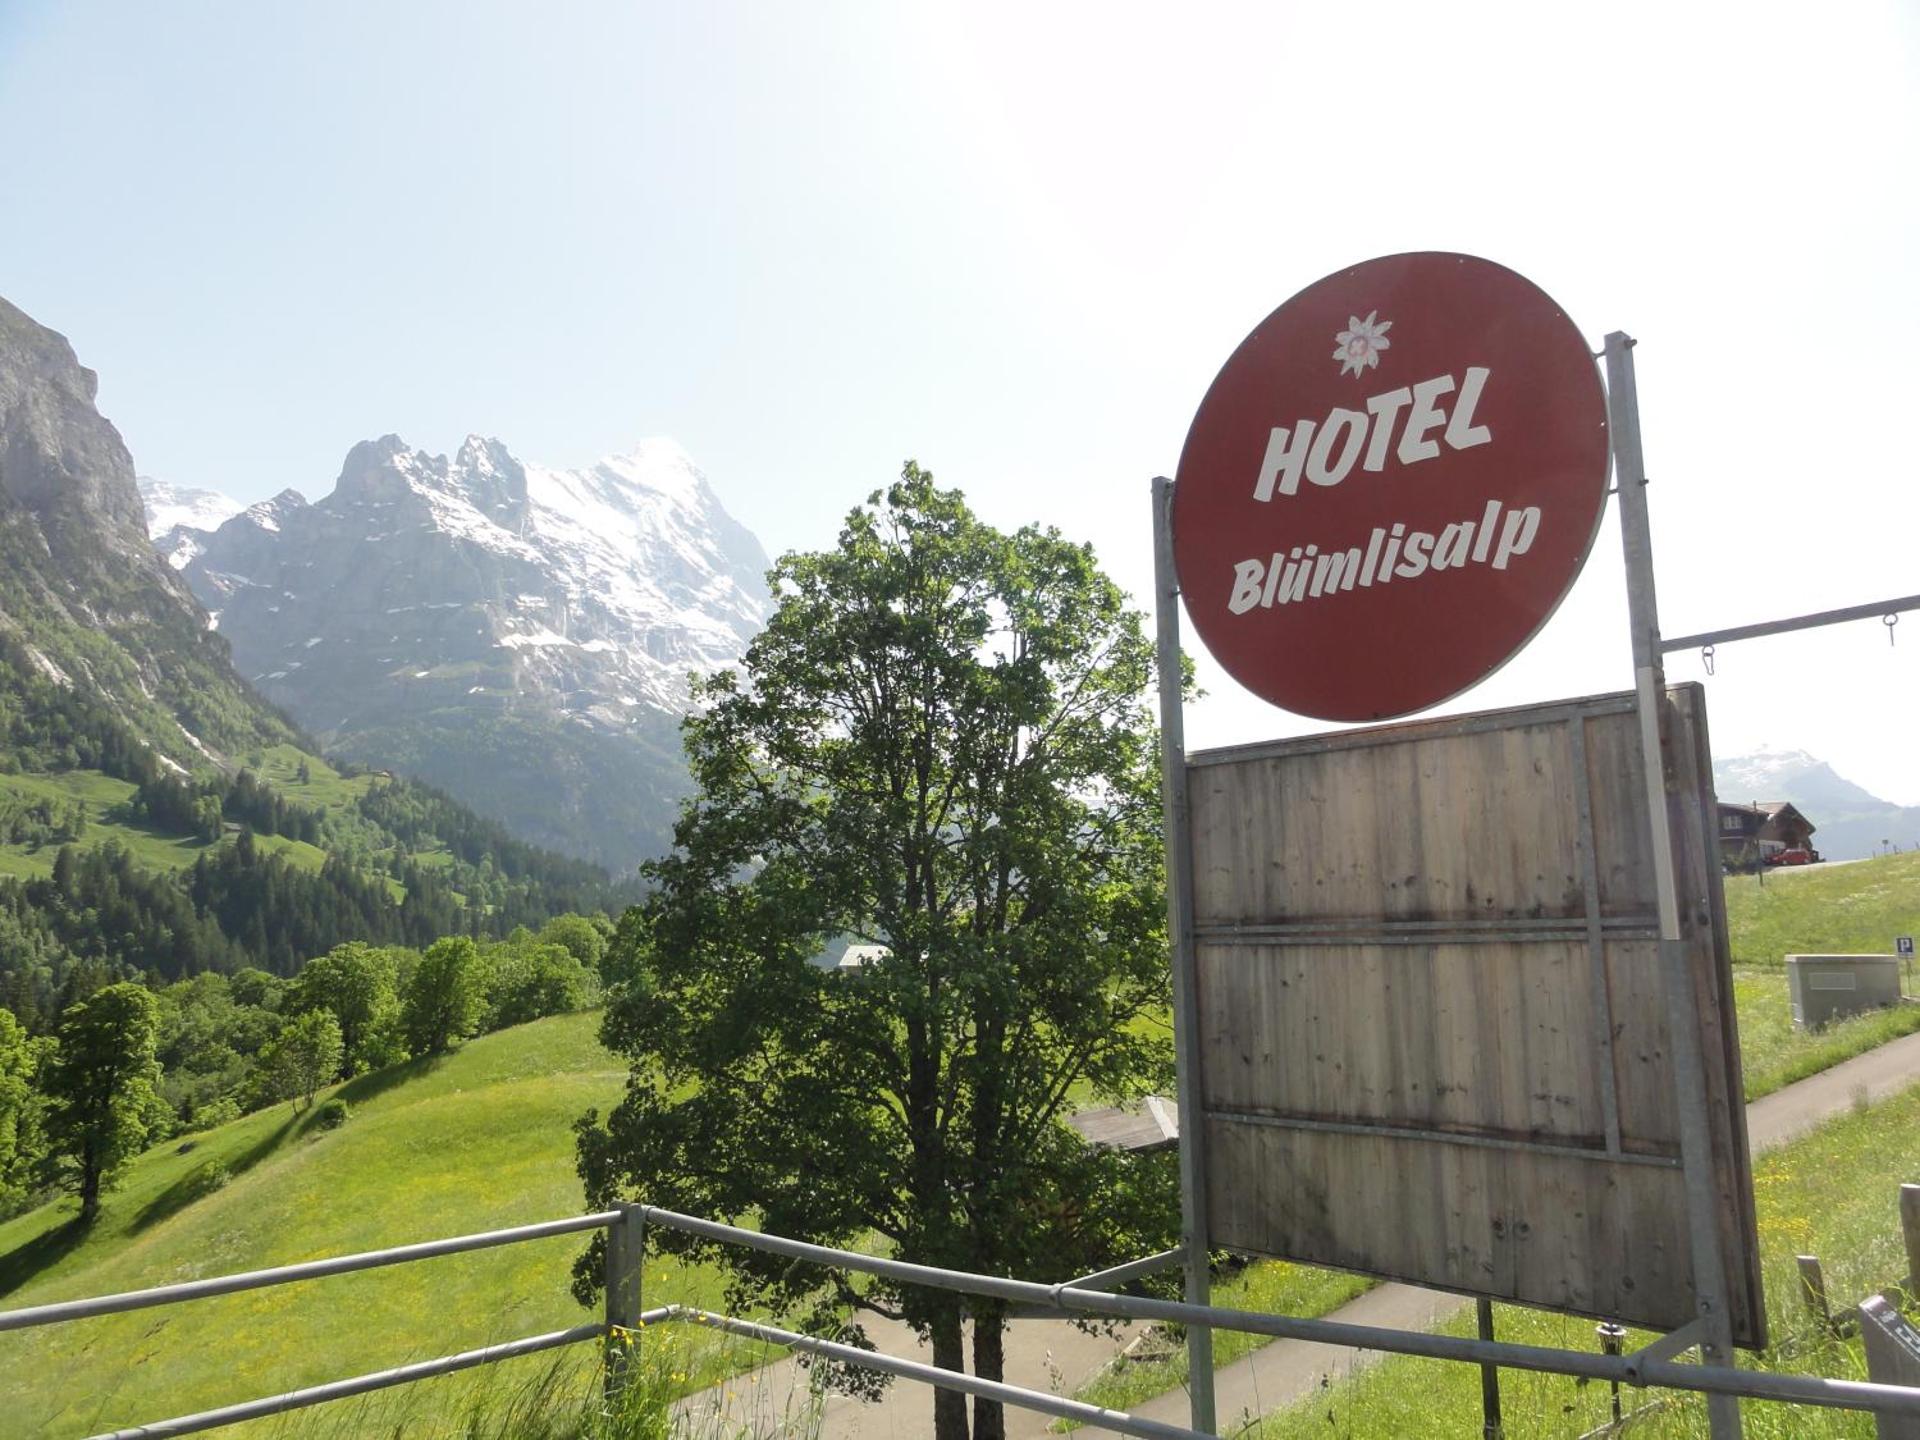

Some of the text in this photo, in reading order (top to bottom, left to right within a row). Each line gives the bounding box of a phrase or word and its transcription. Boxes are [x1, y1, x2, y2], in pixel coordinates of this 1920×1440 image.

[1253, 366, 1492, 502] HOTEL
[1228, 499, 1541, 615] Blümlisalp
[1900, 939, 1910, 952] P
